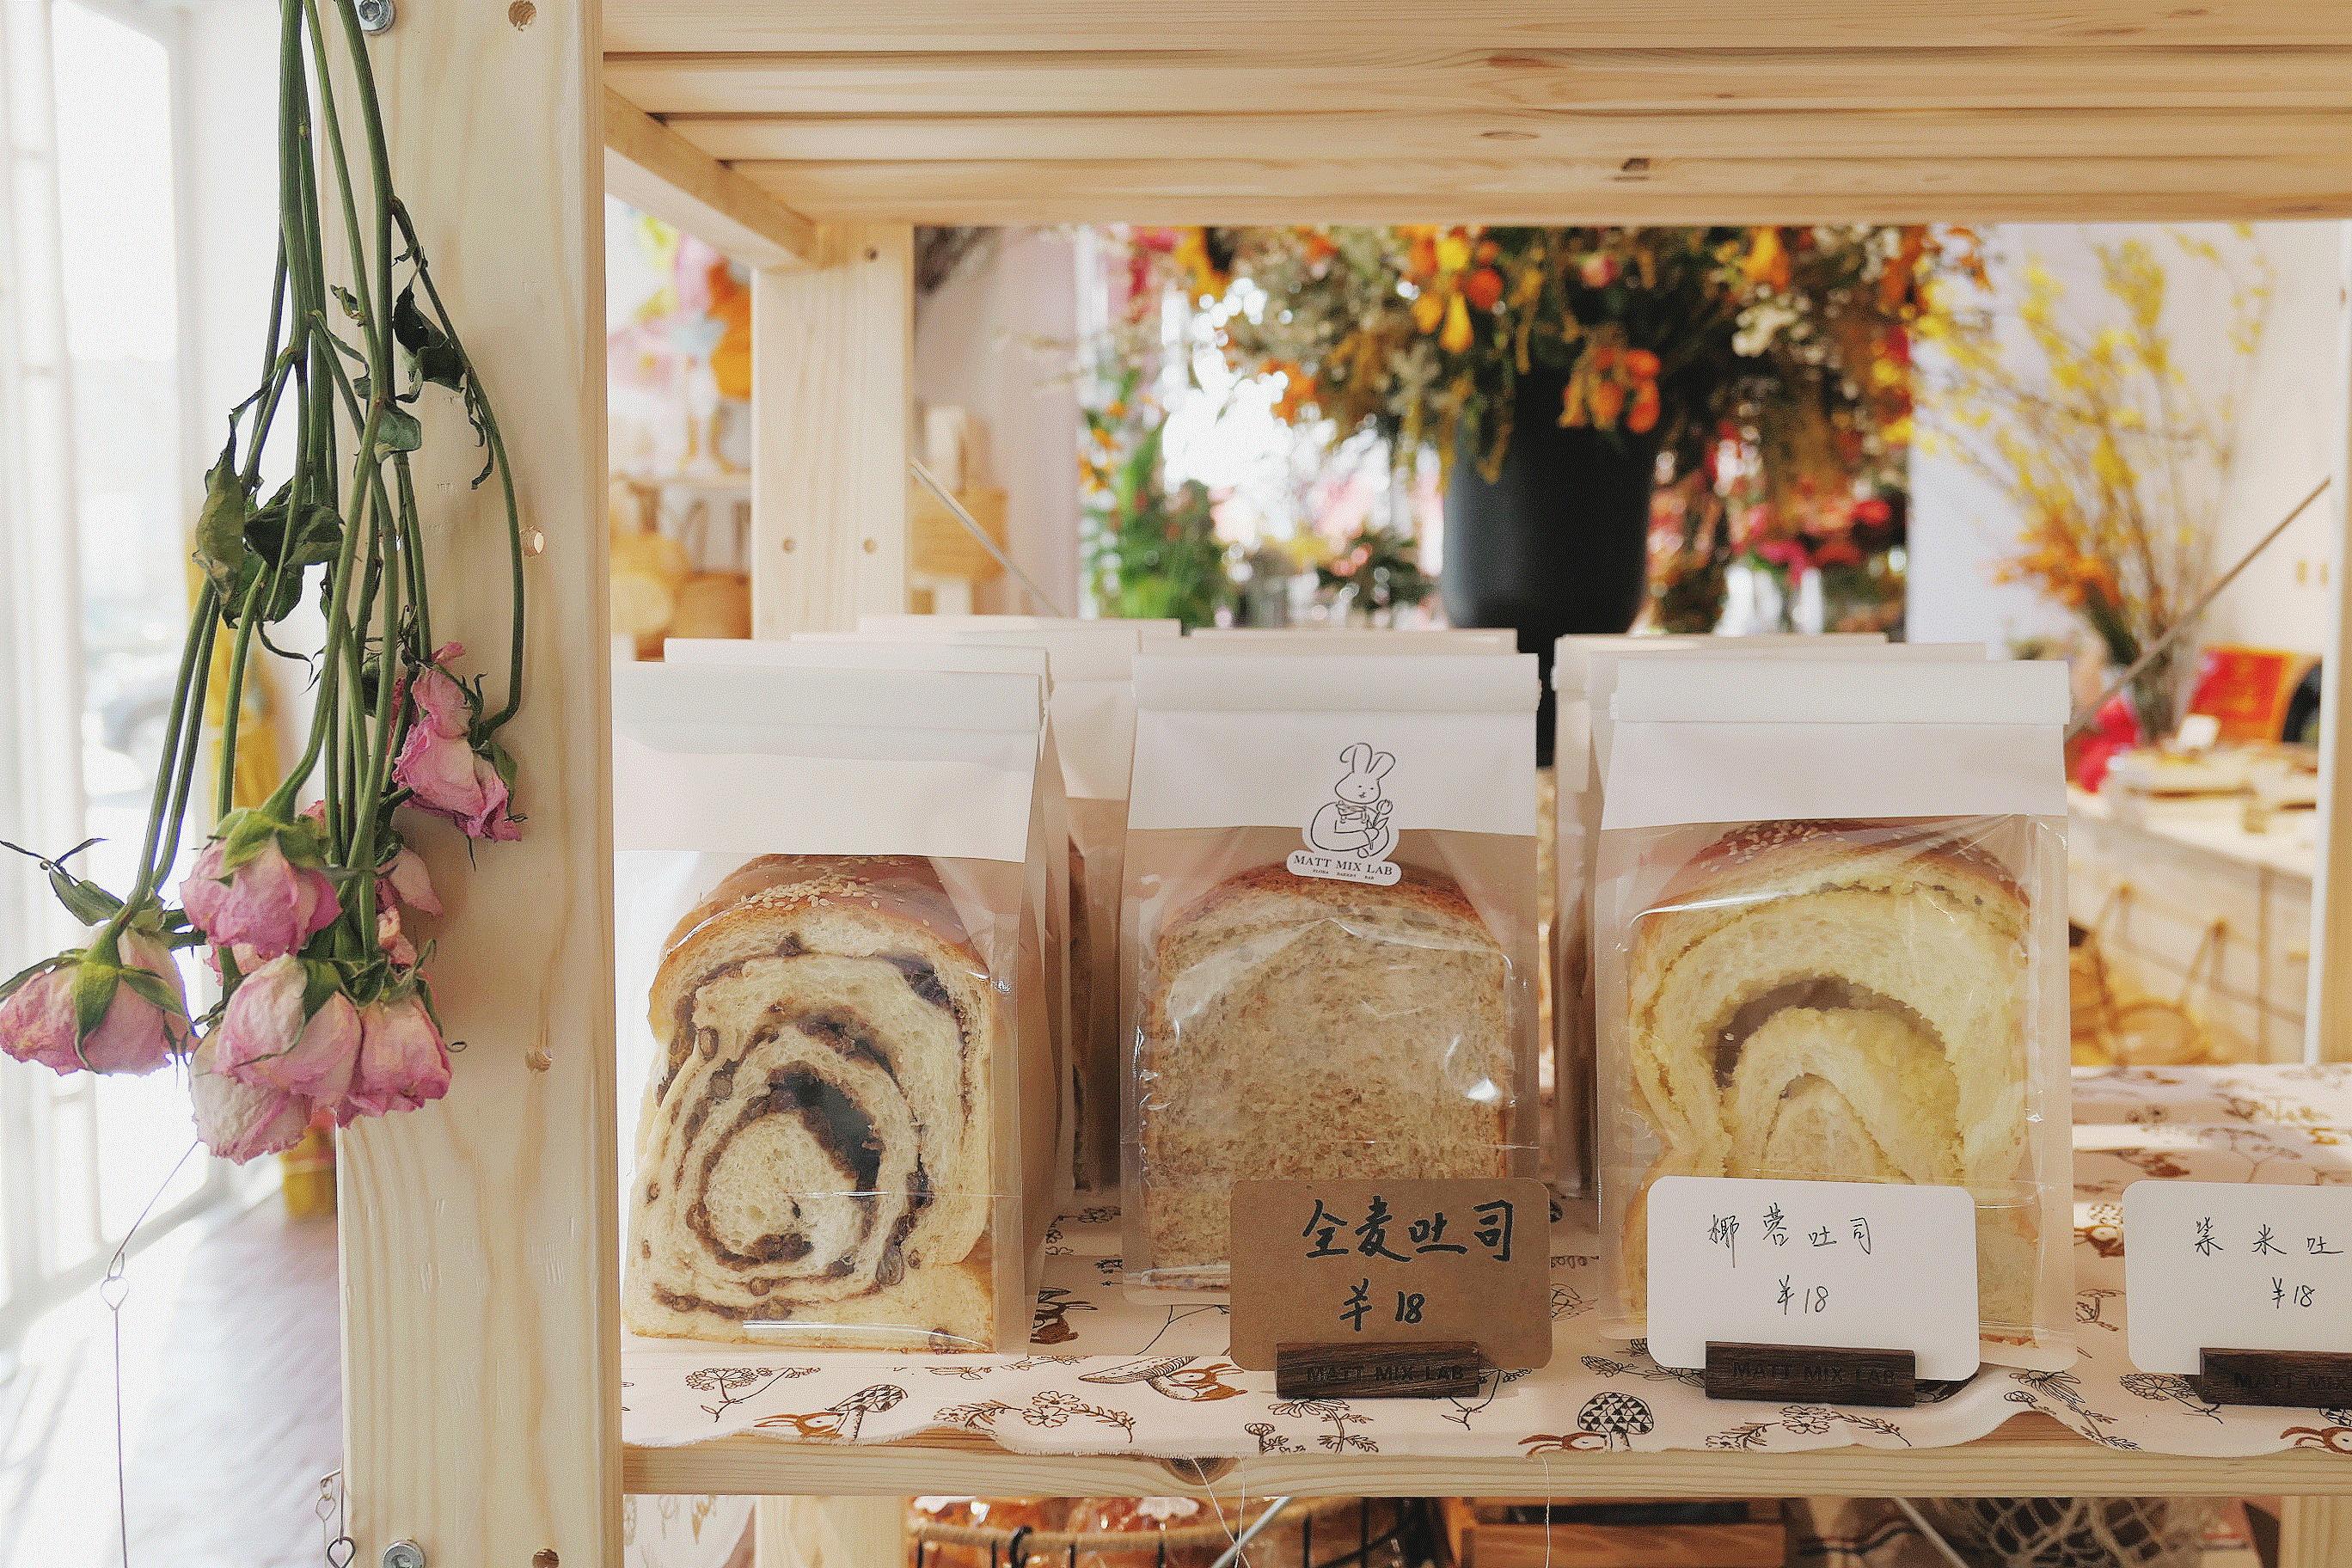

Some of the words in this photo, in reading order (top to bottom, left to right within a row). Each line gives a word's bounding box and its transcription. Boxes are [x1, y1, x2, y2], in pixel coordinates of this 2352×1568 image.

[1294, 854, 1332, 867] MATT
[1336, 861, 1362, 872] MIX
[1367, 864, 1393, 875] LAB
[1302, 1195, 1514, 1263] 全麦吐司
[1706, 1202, 1871, 1269] 椰蓉吐司
[1307, 1365, 1364, 1381] MATT
[1375, 1365, 1413, 1381] MIX
[1425, 1365, 1464, 1381] LAB
[1732, 1362, 1793, 1380] MATT
[1804, 1366, 1843, 1382] MIX
[1855, 1369, 1896, 1385] LAB
